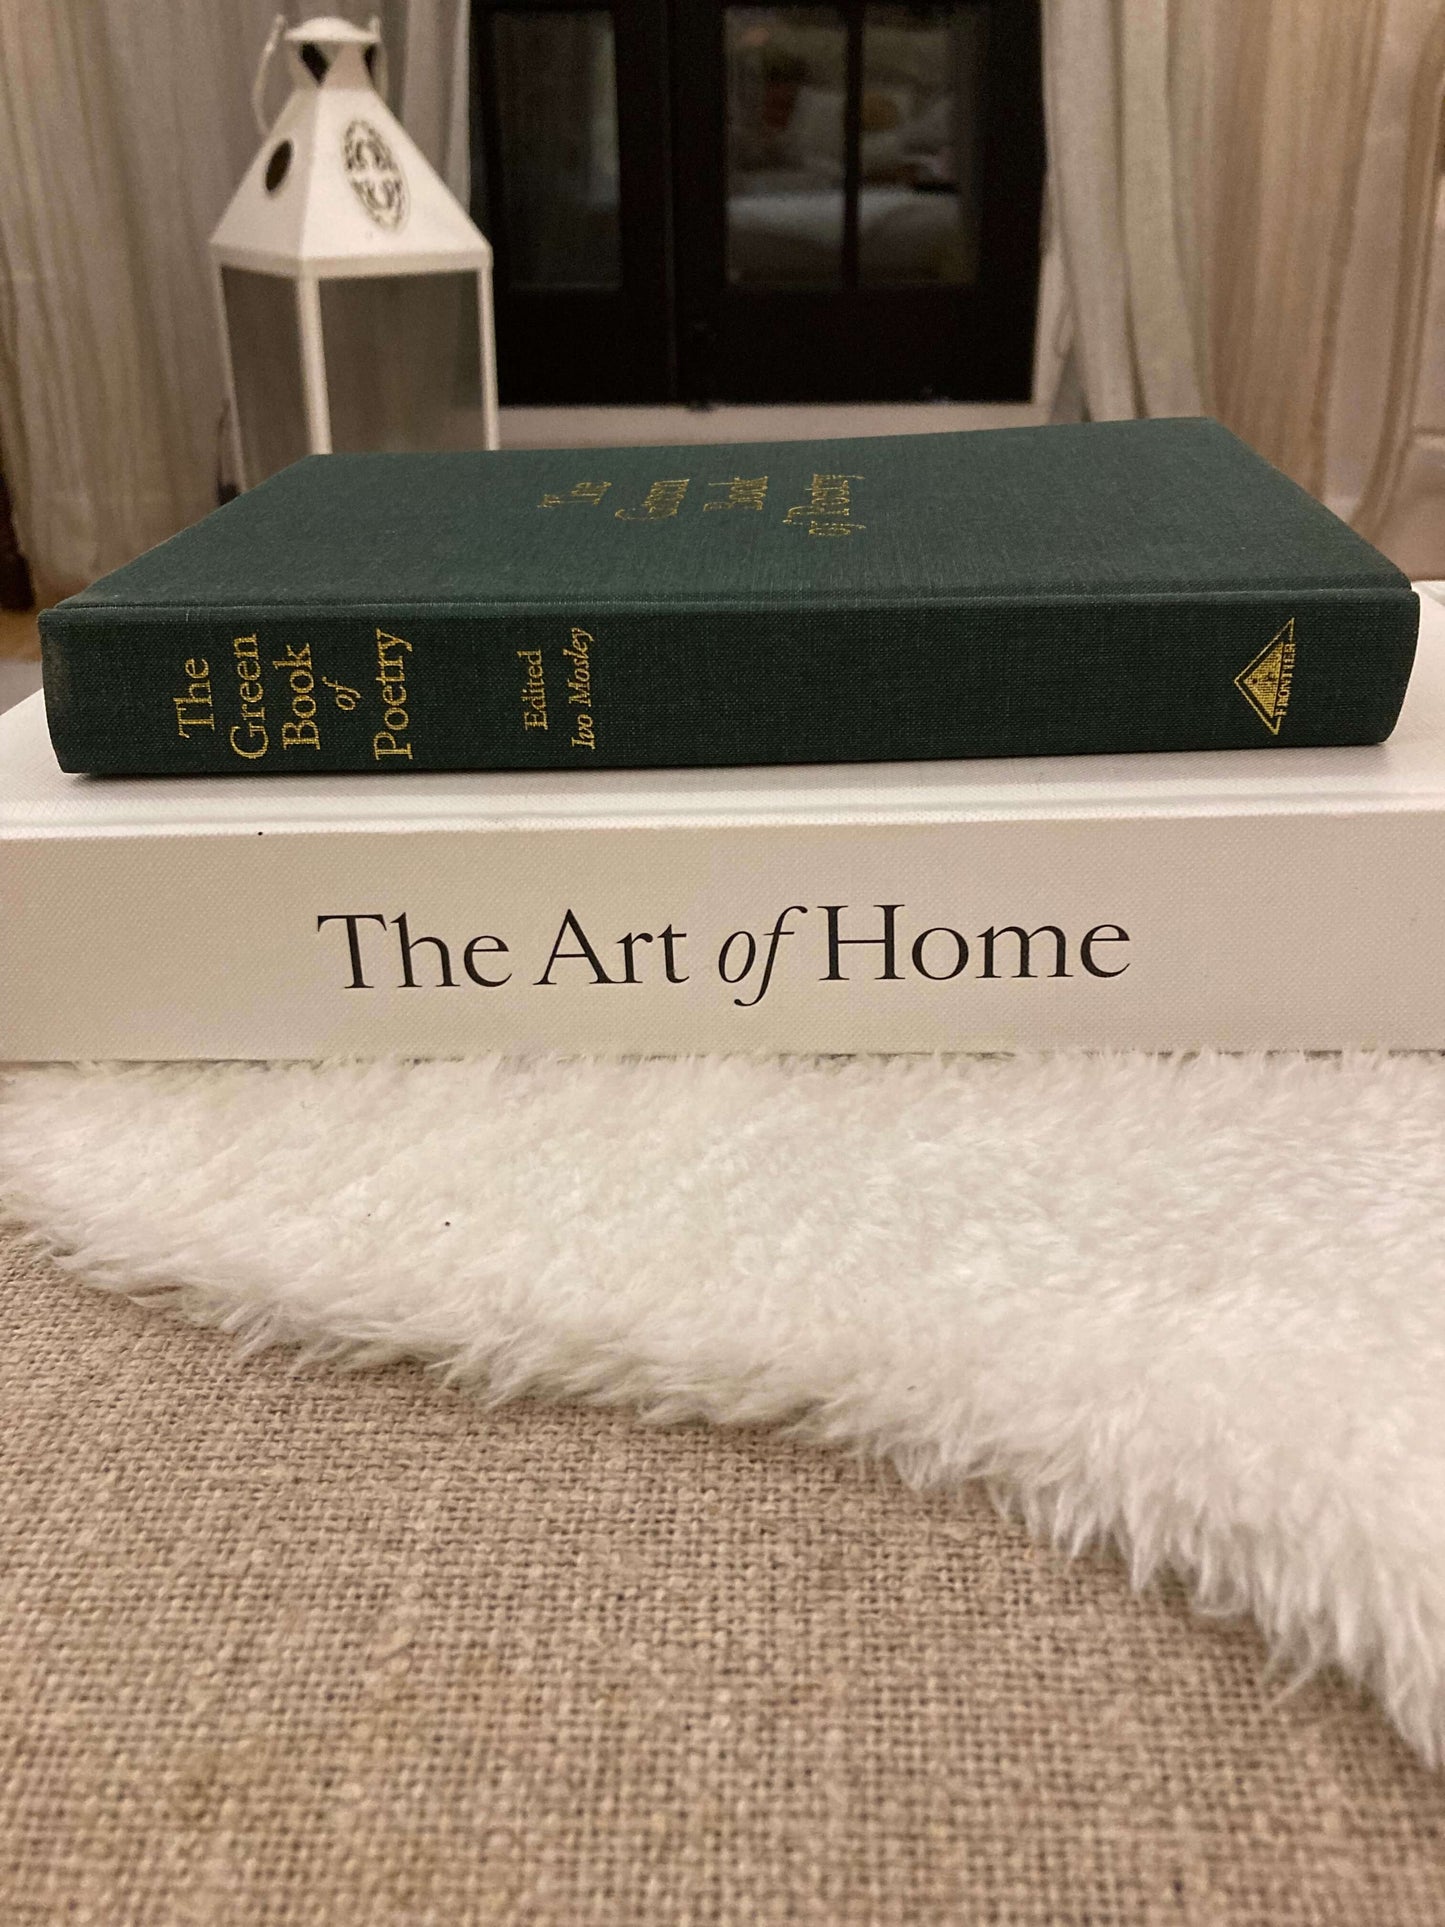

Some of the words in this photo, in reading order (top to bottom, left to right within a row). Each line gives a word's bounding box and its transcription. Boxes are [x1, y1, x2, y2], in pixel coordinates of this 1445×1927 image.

[703, 475, 769, 511] Book
[173, 657, 215, 739] The
[229, 633, 269, 760] Green
[273, 642, 321, 751] Book
[321, 675, 362, 711] of
[372, 627, 413, 761] Poetry
[516, 648, 548, 731] Edited
[562, 626, 595, 707] Mosley
[570, 713, 596, 750] Ivo
[317, 911, 513, 990] The
[532, 907, 690, 986] Art
[717, 904, 809, 1007] of
[817, 903, 1131, 982] Home
